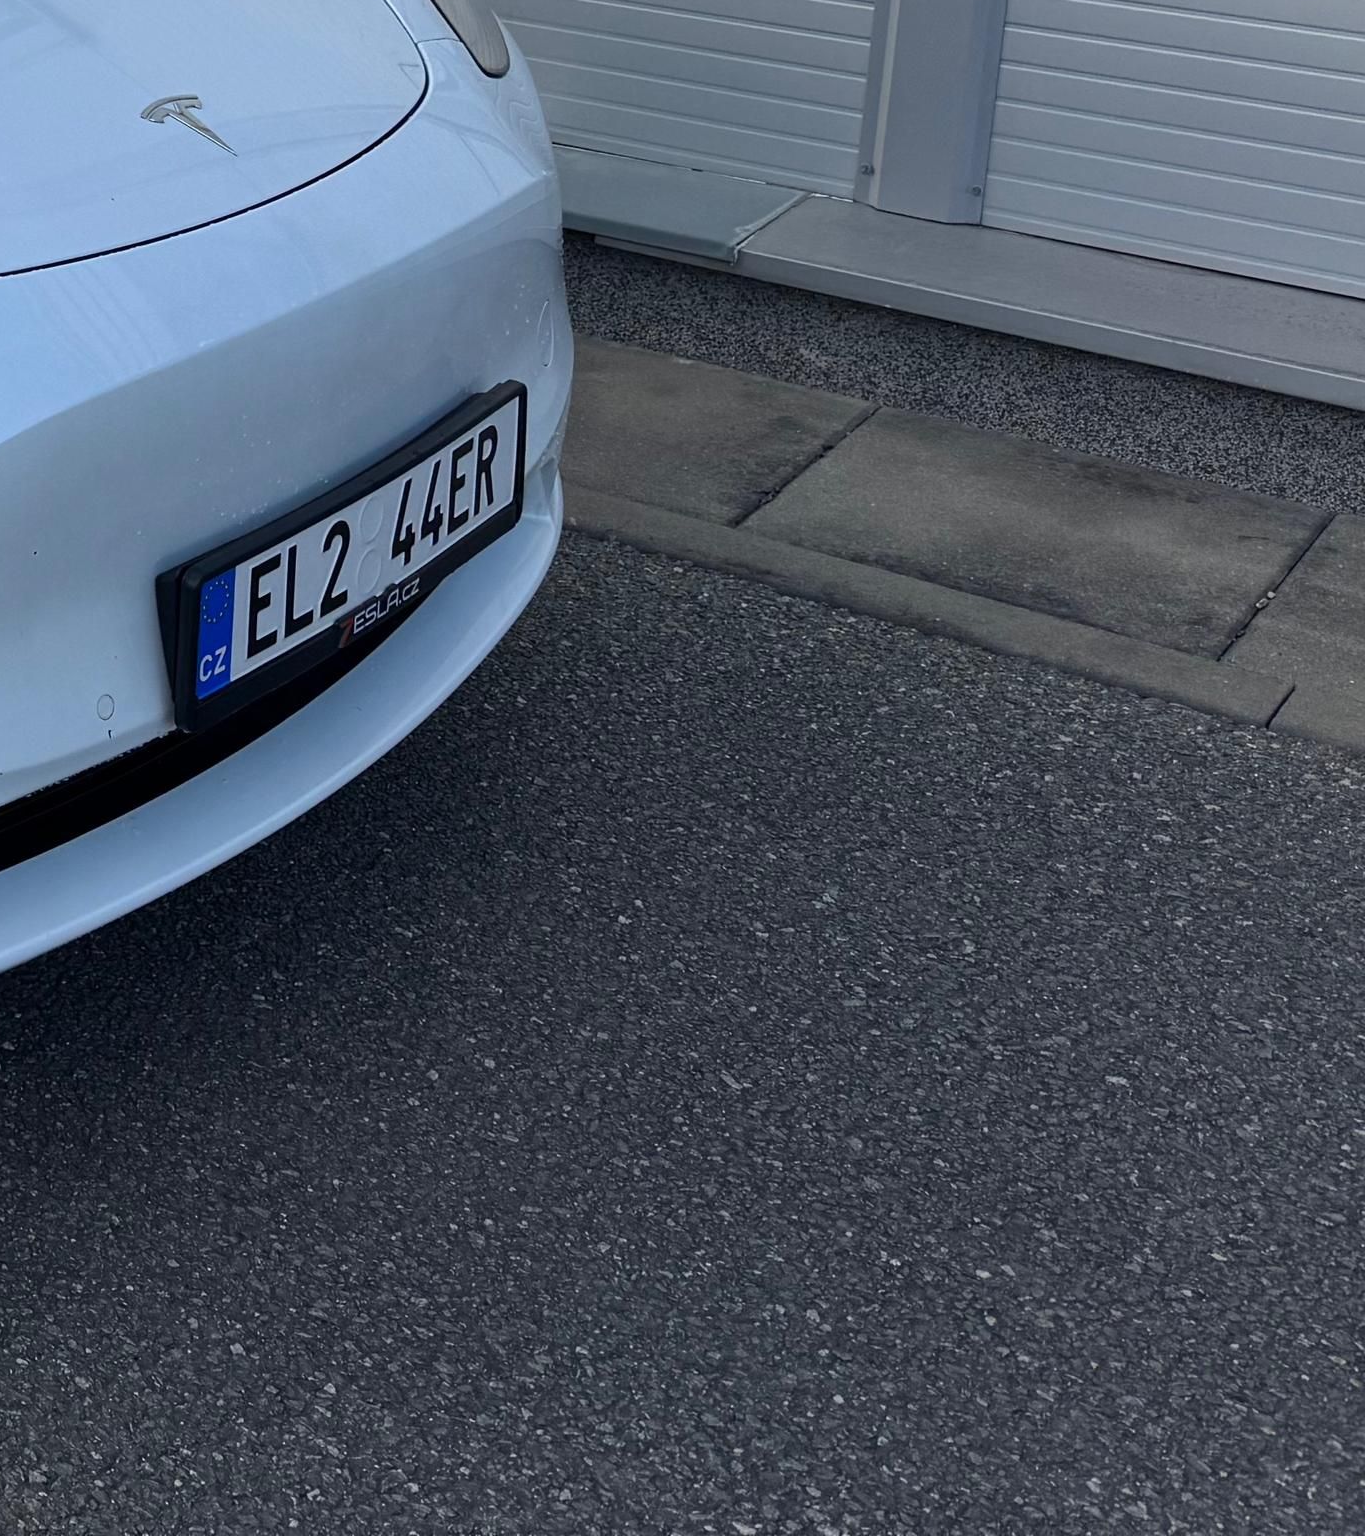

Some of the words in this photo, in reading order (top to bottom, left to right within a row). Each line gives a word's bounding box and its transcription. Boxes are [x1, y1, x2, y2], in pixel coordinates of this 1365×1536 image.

[246, 520, 350, 659] EL2
[391, 425, 498, 566] 44ER
[199, 645, 227, 682] CZ
